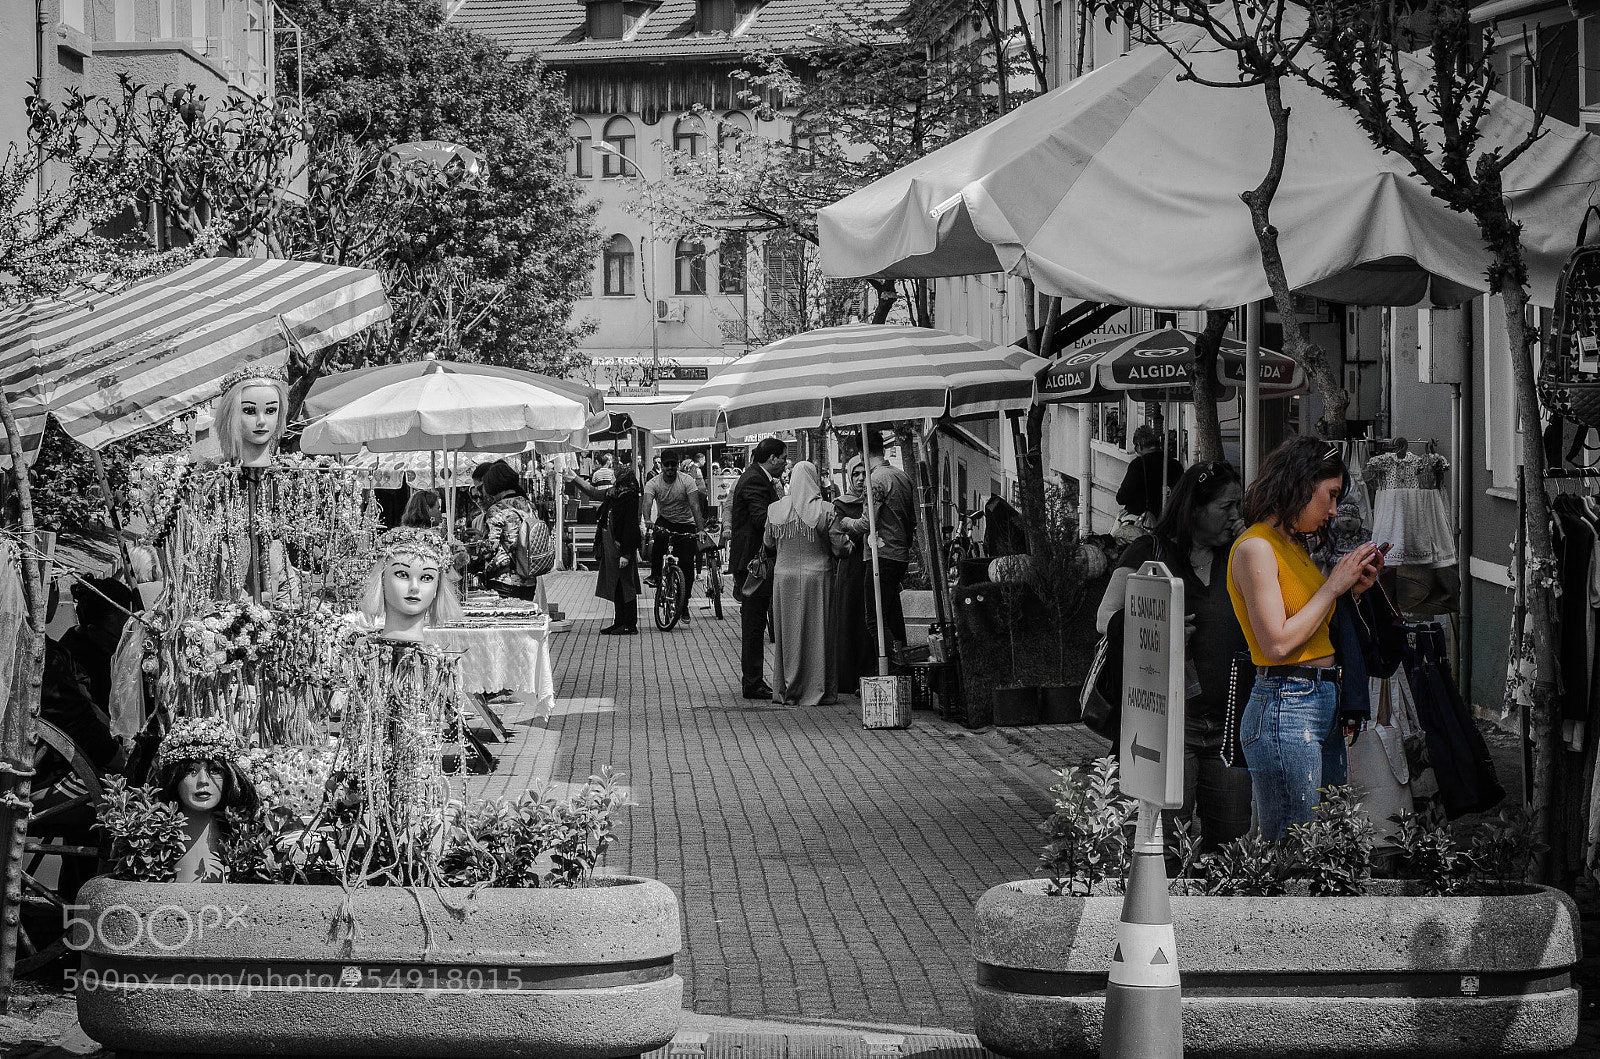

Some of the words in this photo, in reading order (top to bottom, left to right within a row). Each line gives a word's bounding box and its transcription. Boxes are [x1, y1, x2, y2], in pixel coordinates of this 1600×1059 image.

[1092, 323, 1128, 335] HAN
[1235, 363, 1282, 378] AiDA
[1130, 594, 1137, 617] EL
[1137, 595, 1167, 622] SANATLARI
[1139, 623, 1161, 653] SOKAĞI
